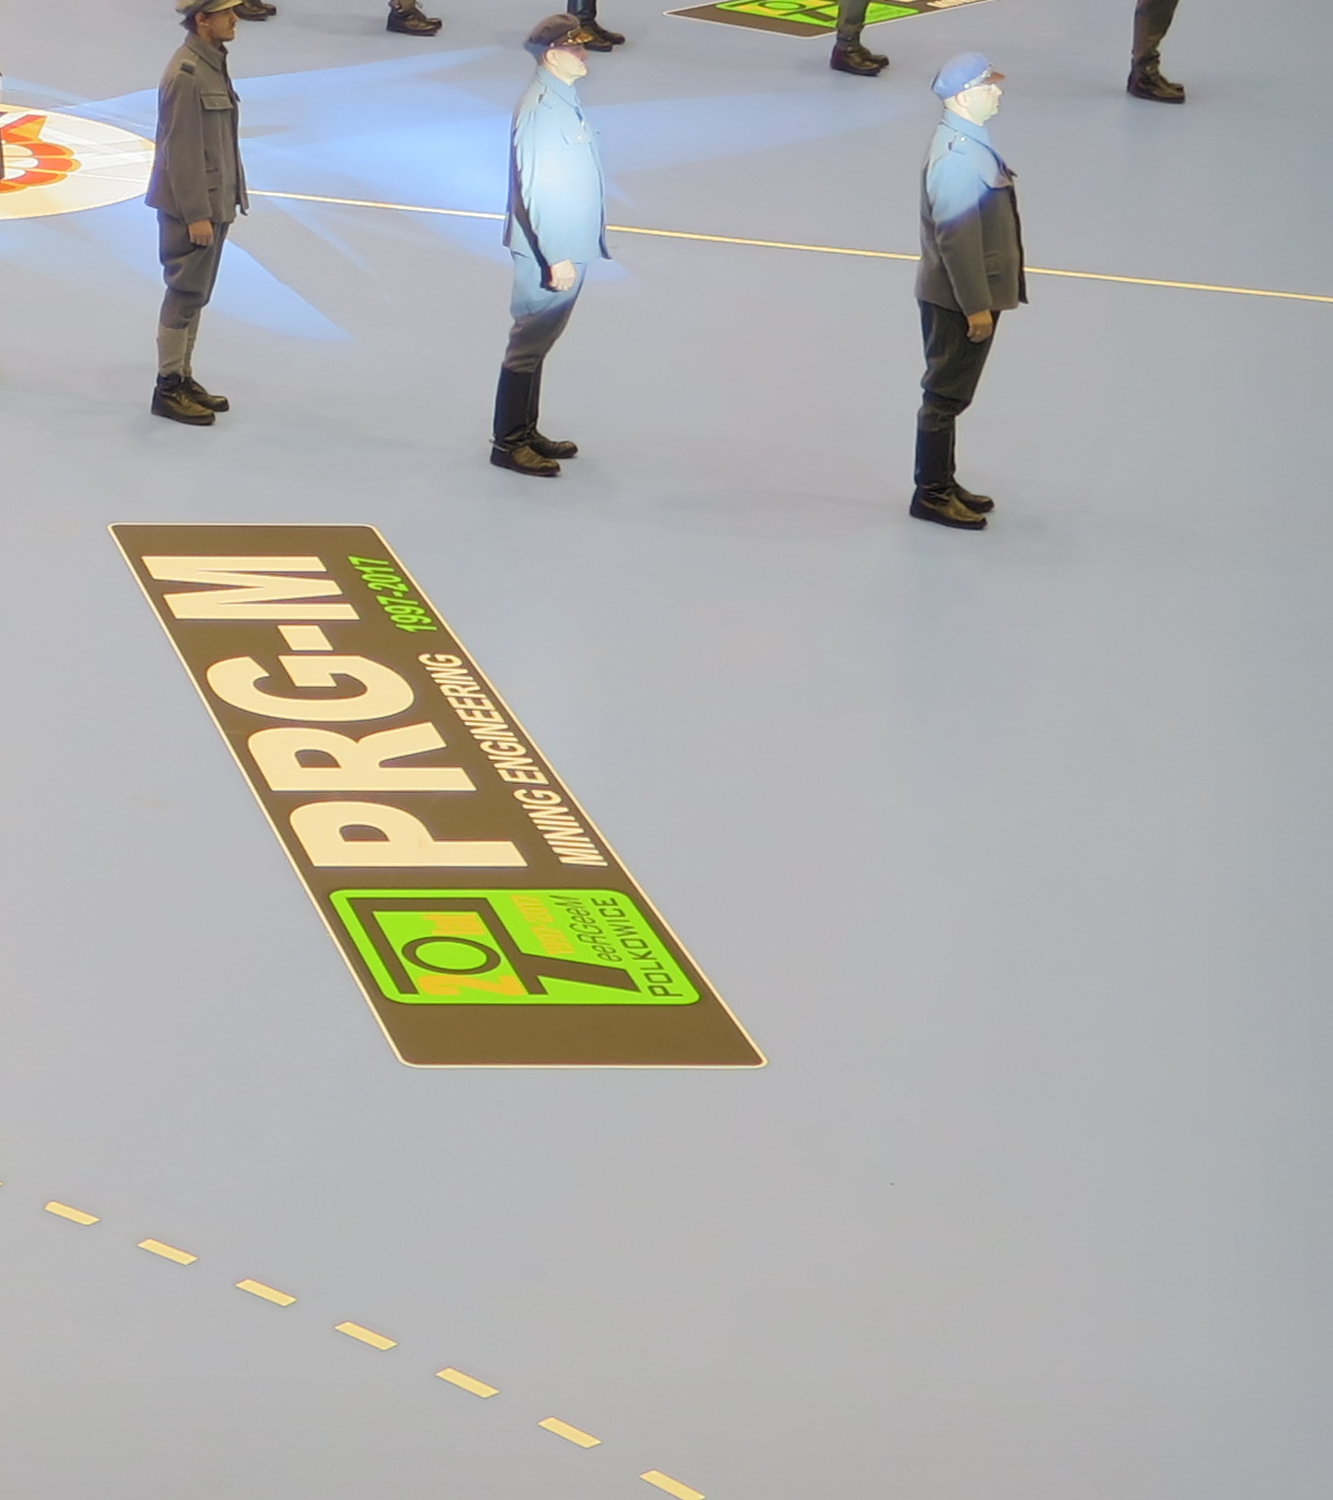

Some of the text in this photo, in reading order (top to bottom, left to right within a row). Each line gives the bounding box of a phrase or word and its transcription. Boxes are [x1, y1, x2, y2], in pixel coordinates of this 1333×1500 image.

[346, 554, 438, 634] 1997-2017
[140, 555, 528, 868] PRG-M
[417, 652, 550, 786] ENGINEERING
[513, 788, 610, 867] MINING
[590, 896, 684, 998] POLKOWICE
